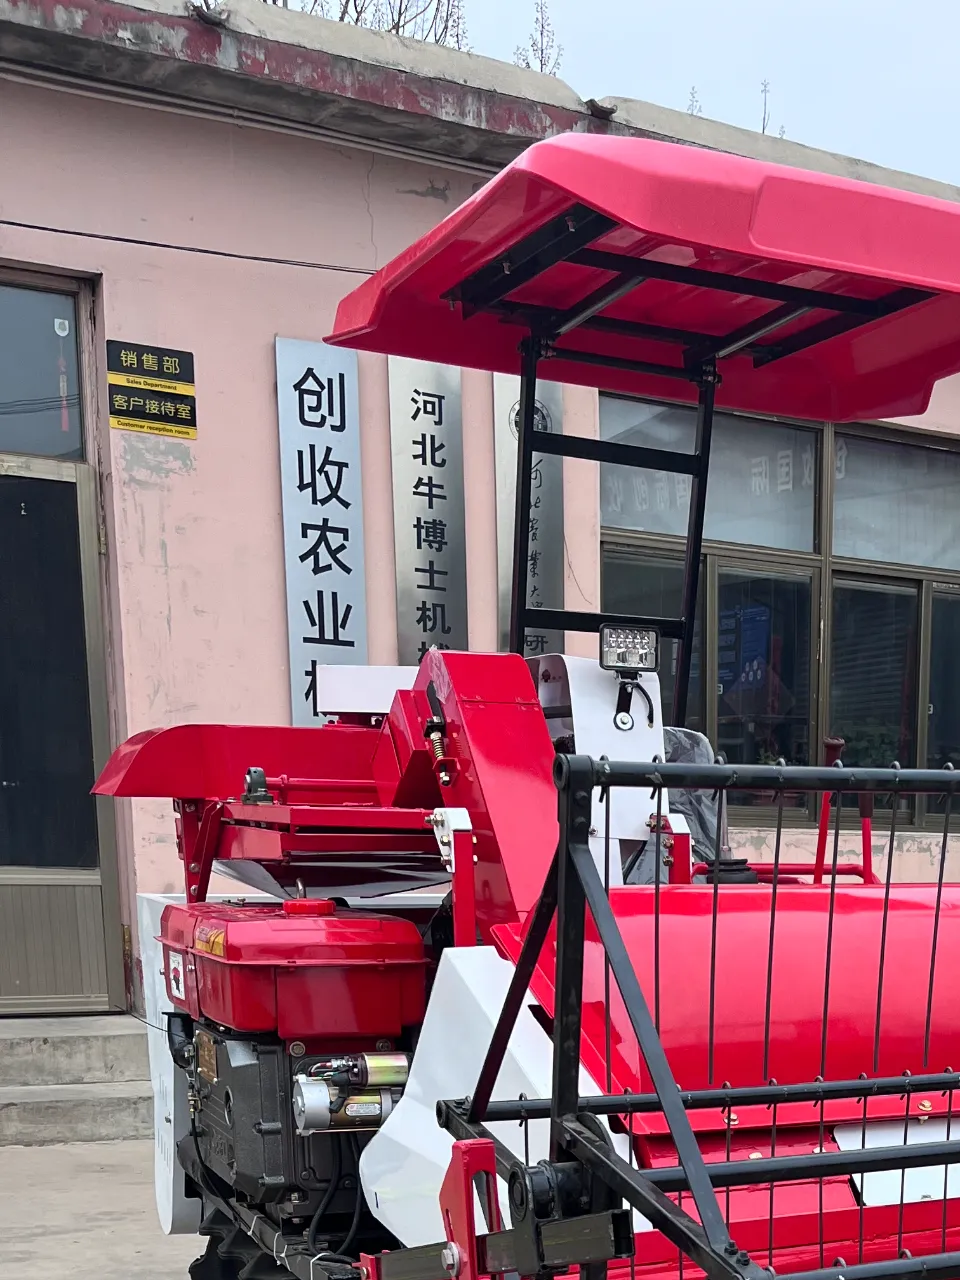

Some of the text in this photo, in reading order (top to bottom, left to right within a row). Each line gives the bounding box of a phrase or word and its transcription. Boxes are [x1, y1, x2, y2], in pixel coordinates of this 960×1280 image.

[120, 349, 180, 374] 销售部
[126, 378, 177, 391] Sales Department
[112, 394, 192, 419] 客户接待室
[117, 420, 146, 429] Customer
[146, 424, 174, 434] reception
